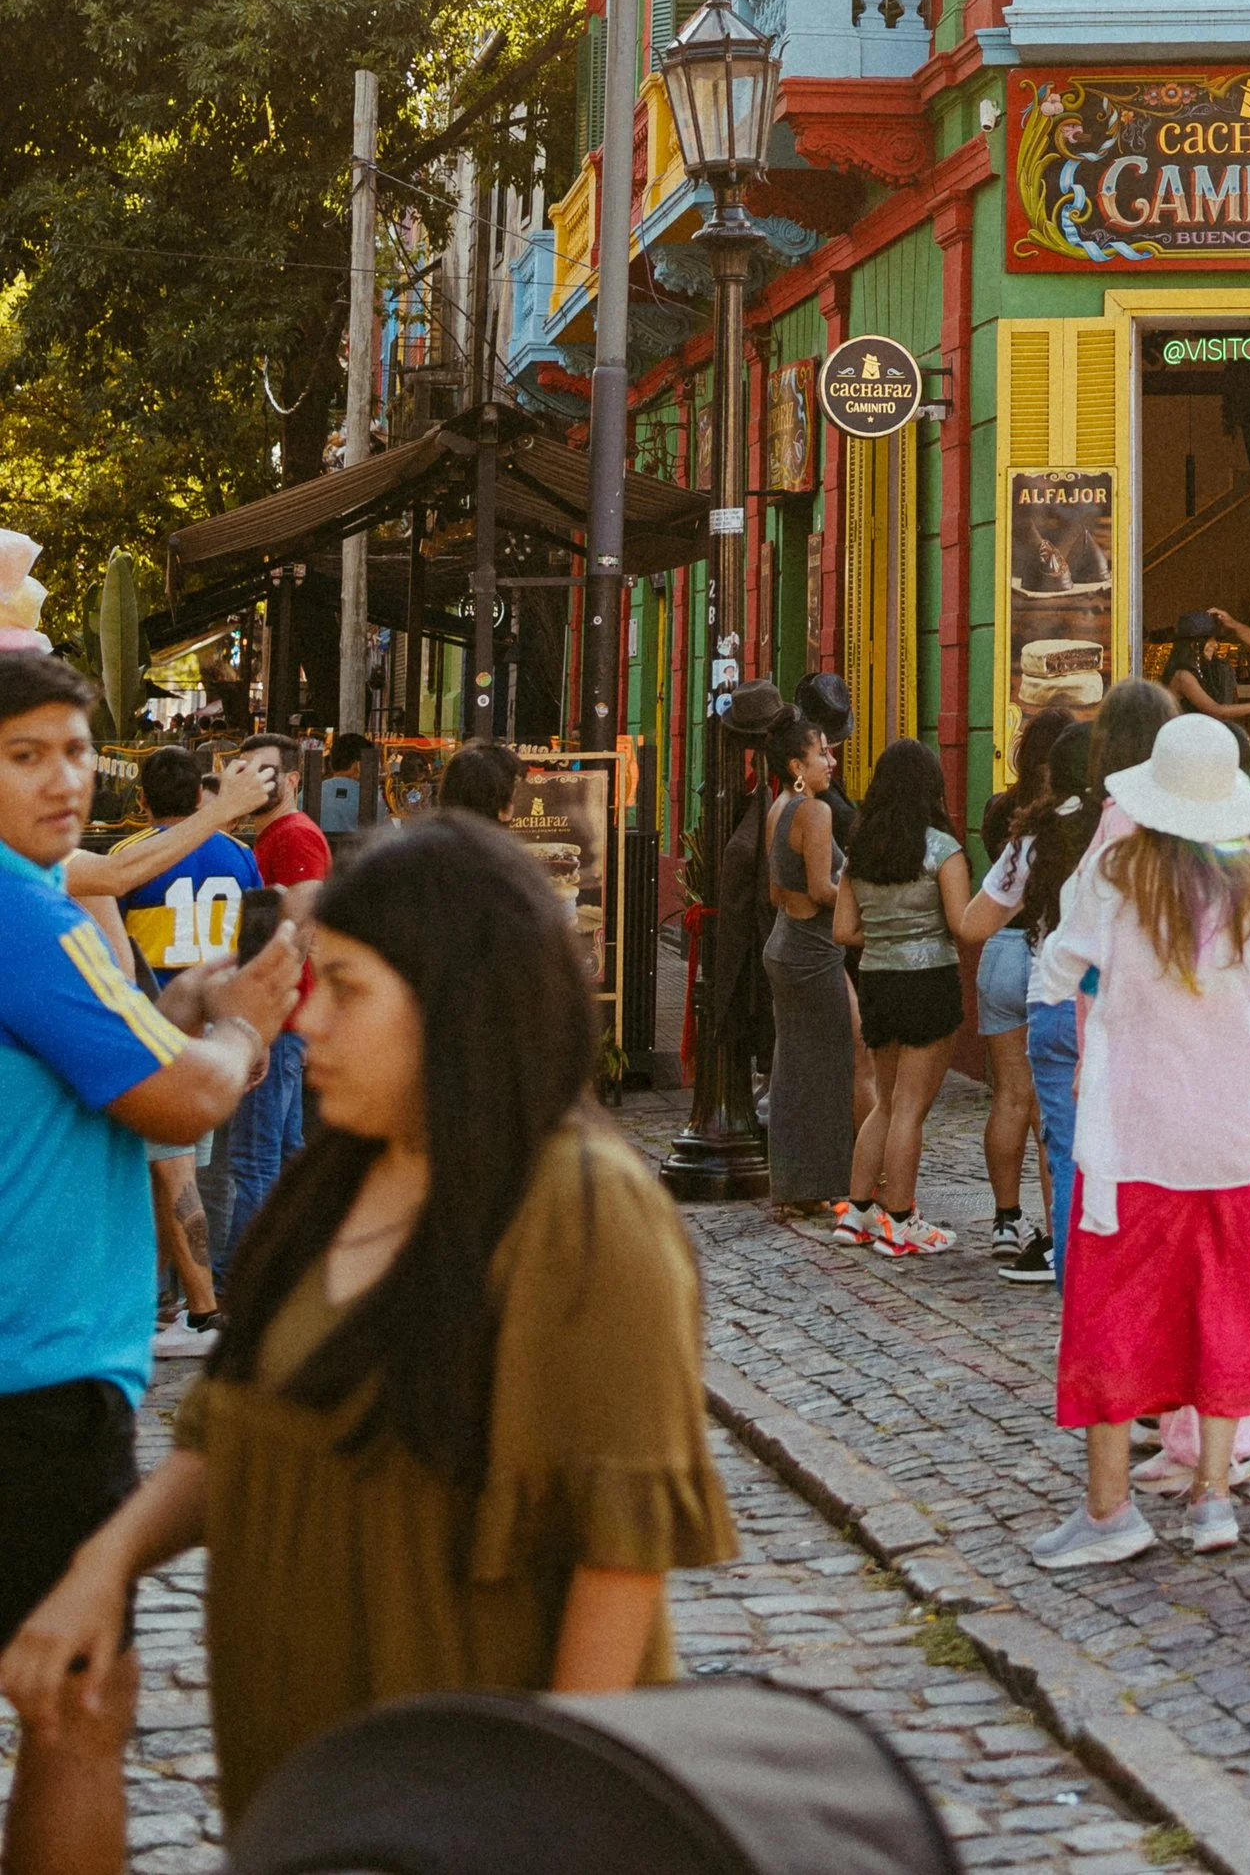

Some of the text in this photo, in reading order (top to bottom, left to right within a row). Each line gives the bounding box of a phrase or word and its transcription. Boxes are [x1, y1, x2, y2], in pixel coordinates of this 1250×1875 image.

[845, 400, 896, 414] CAMINITO
[1018, 487, 1108, 505] ALFAJOR
[164, 876, 243, 964] 10
